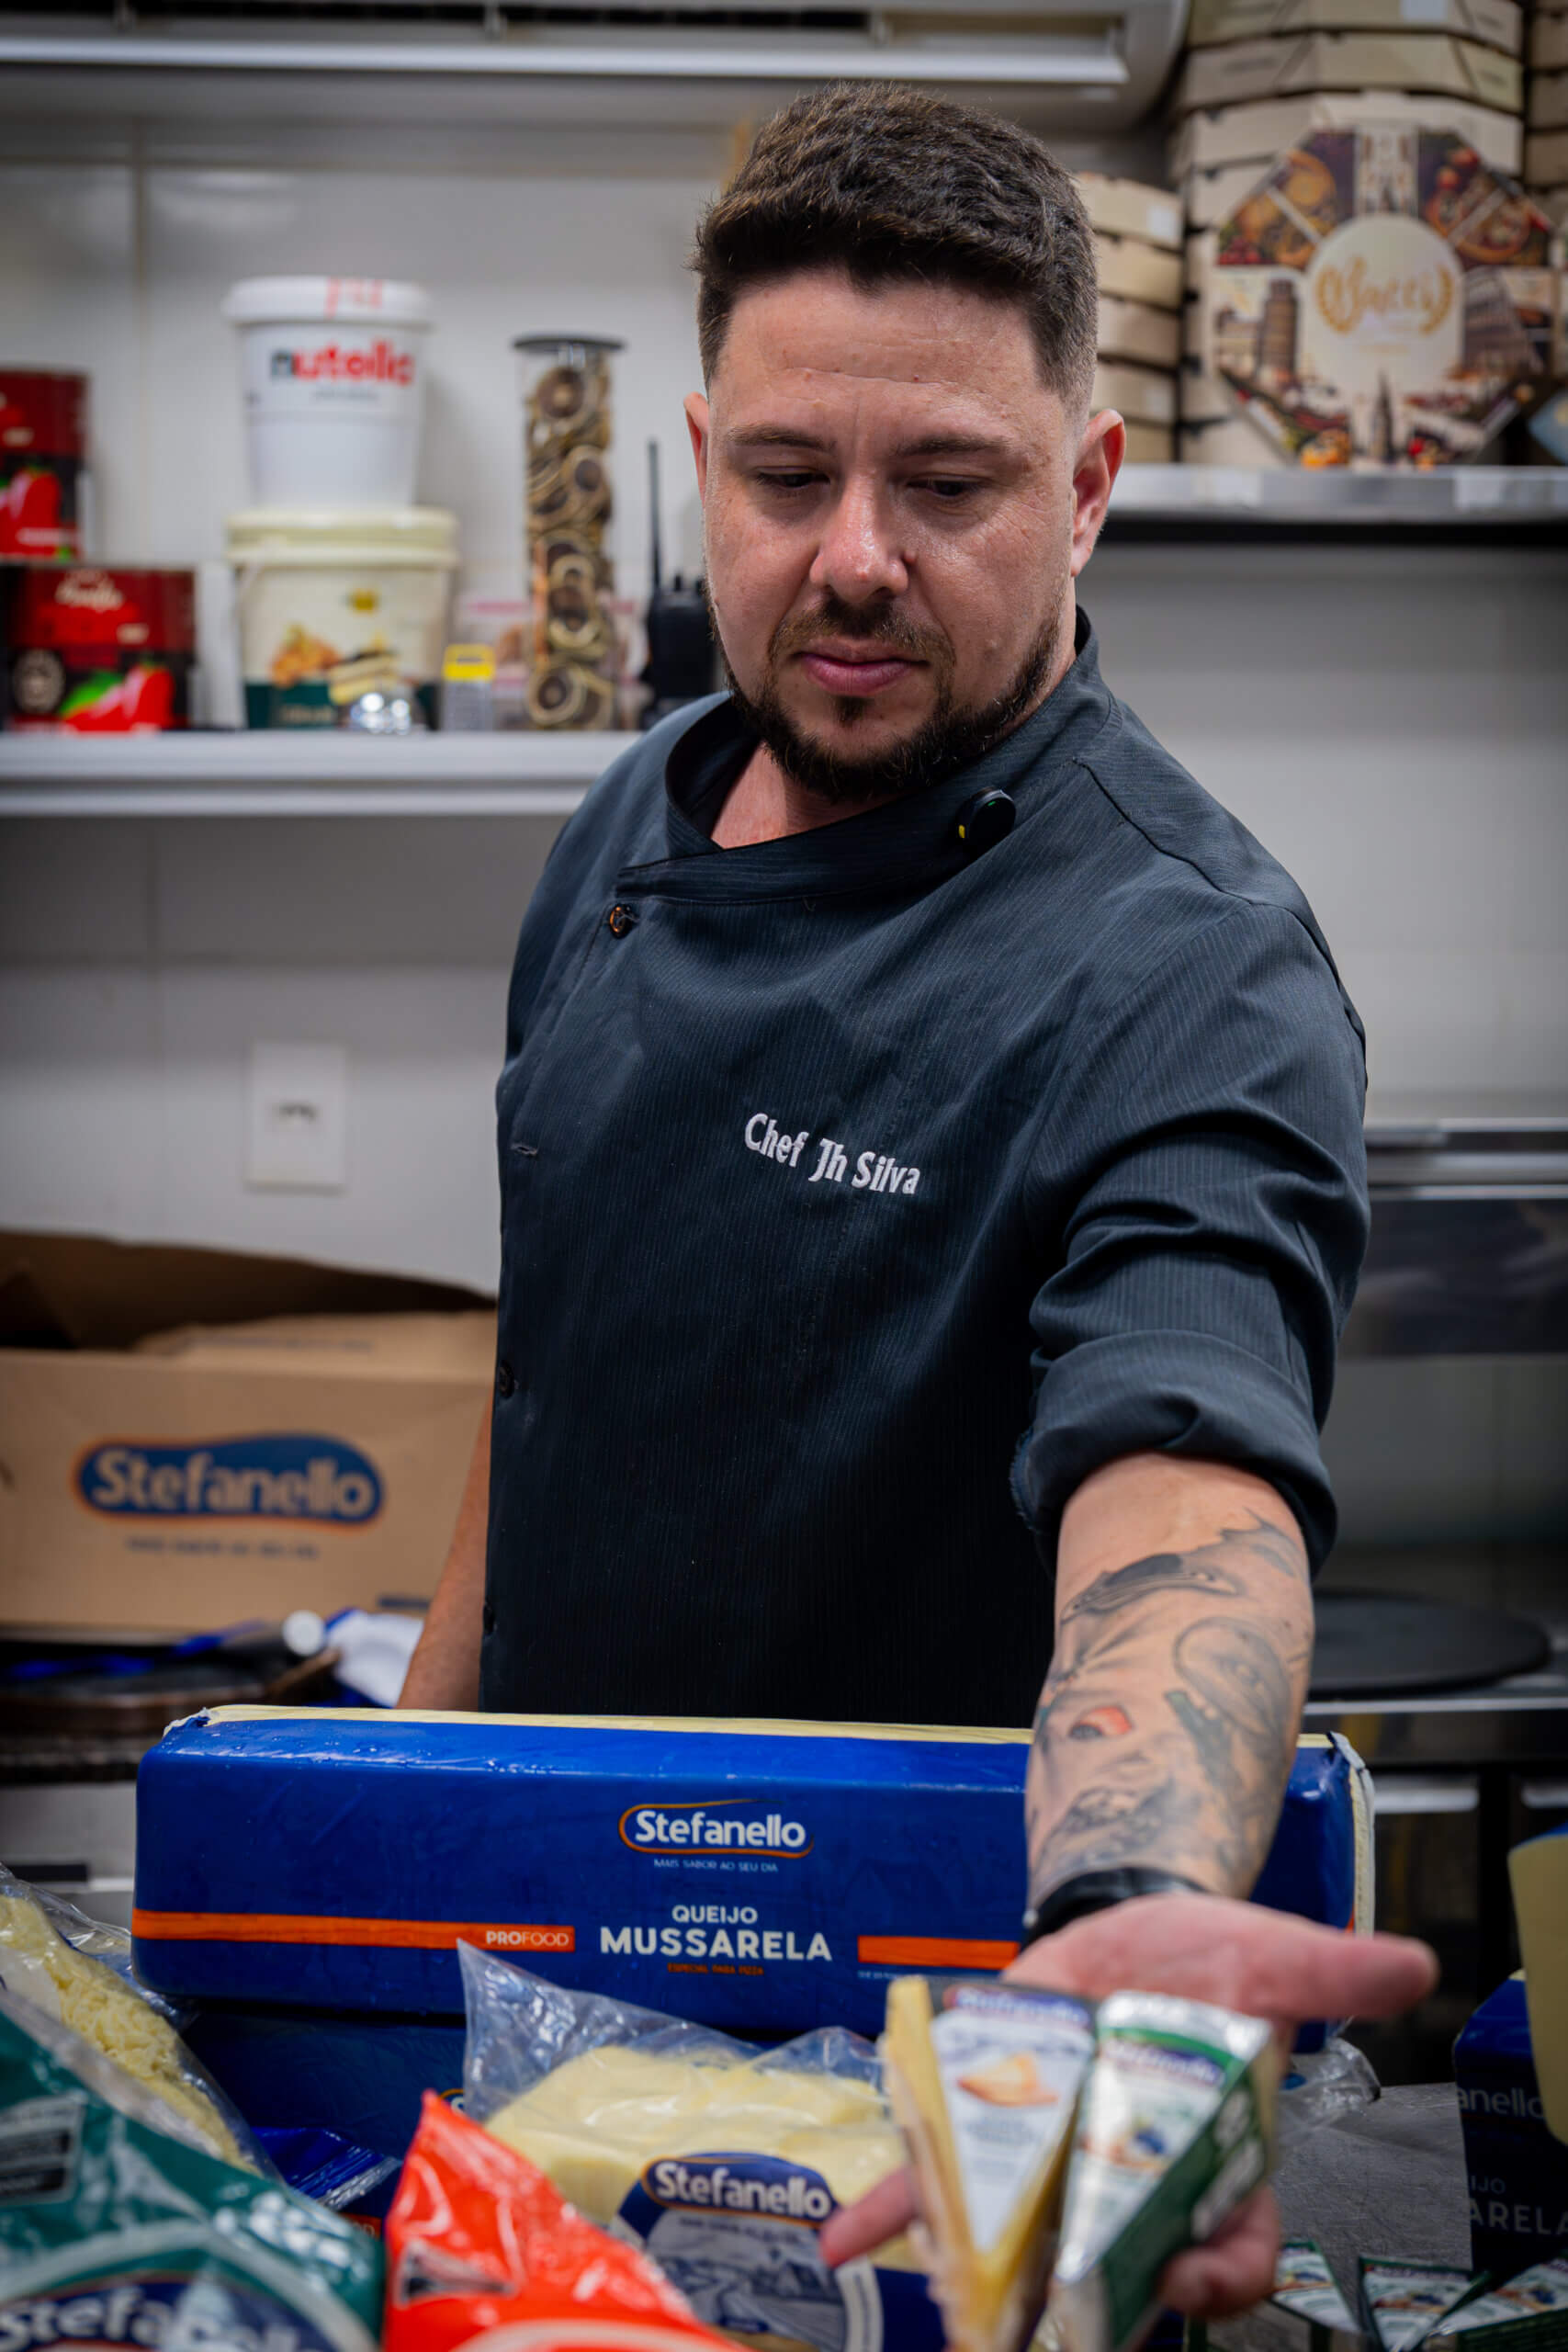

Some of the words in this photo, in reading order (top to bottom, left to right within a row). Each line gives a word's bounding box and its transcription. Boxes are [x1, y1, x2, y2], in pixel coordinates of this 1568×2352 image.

[744, 1113, 809, 1168] Chef
[807, 1137, 848, 1182] Jh
[851, 1151, 920, 1194] Silva
[94, 1448, 374, 1516] Stefanello
[635, 1810, 807, 1848] Stefanello
[653, 1858, 679, 1869] MAIS
[719, 1861, 735, 1871] AO
[739, 1862, 759, 1872] SEU
[761, 1863, 779, 1872] DIA
[671, 1905, 759, 1925] QUEIJO
[485, 1930, 570, 1947] PROFOOD
[600, 1926, 833, 1962] MUSSARELA
[1456, 2086, 1545, 2120] anello
[654, 2161, 831, 2219] Stefanello
